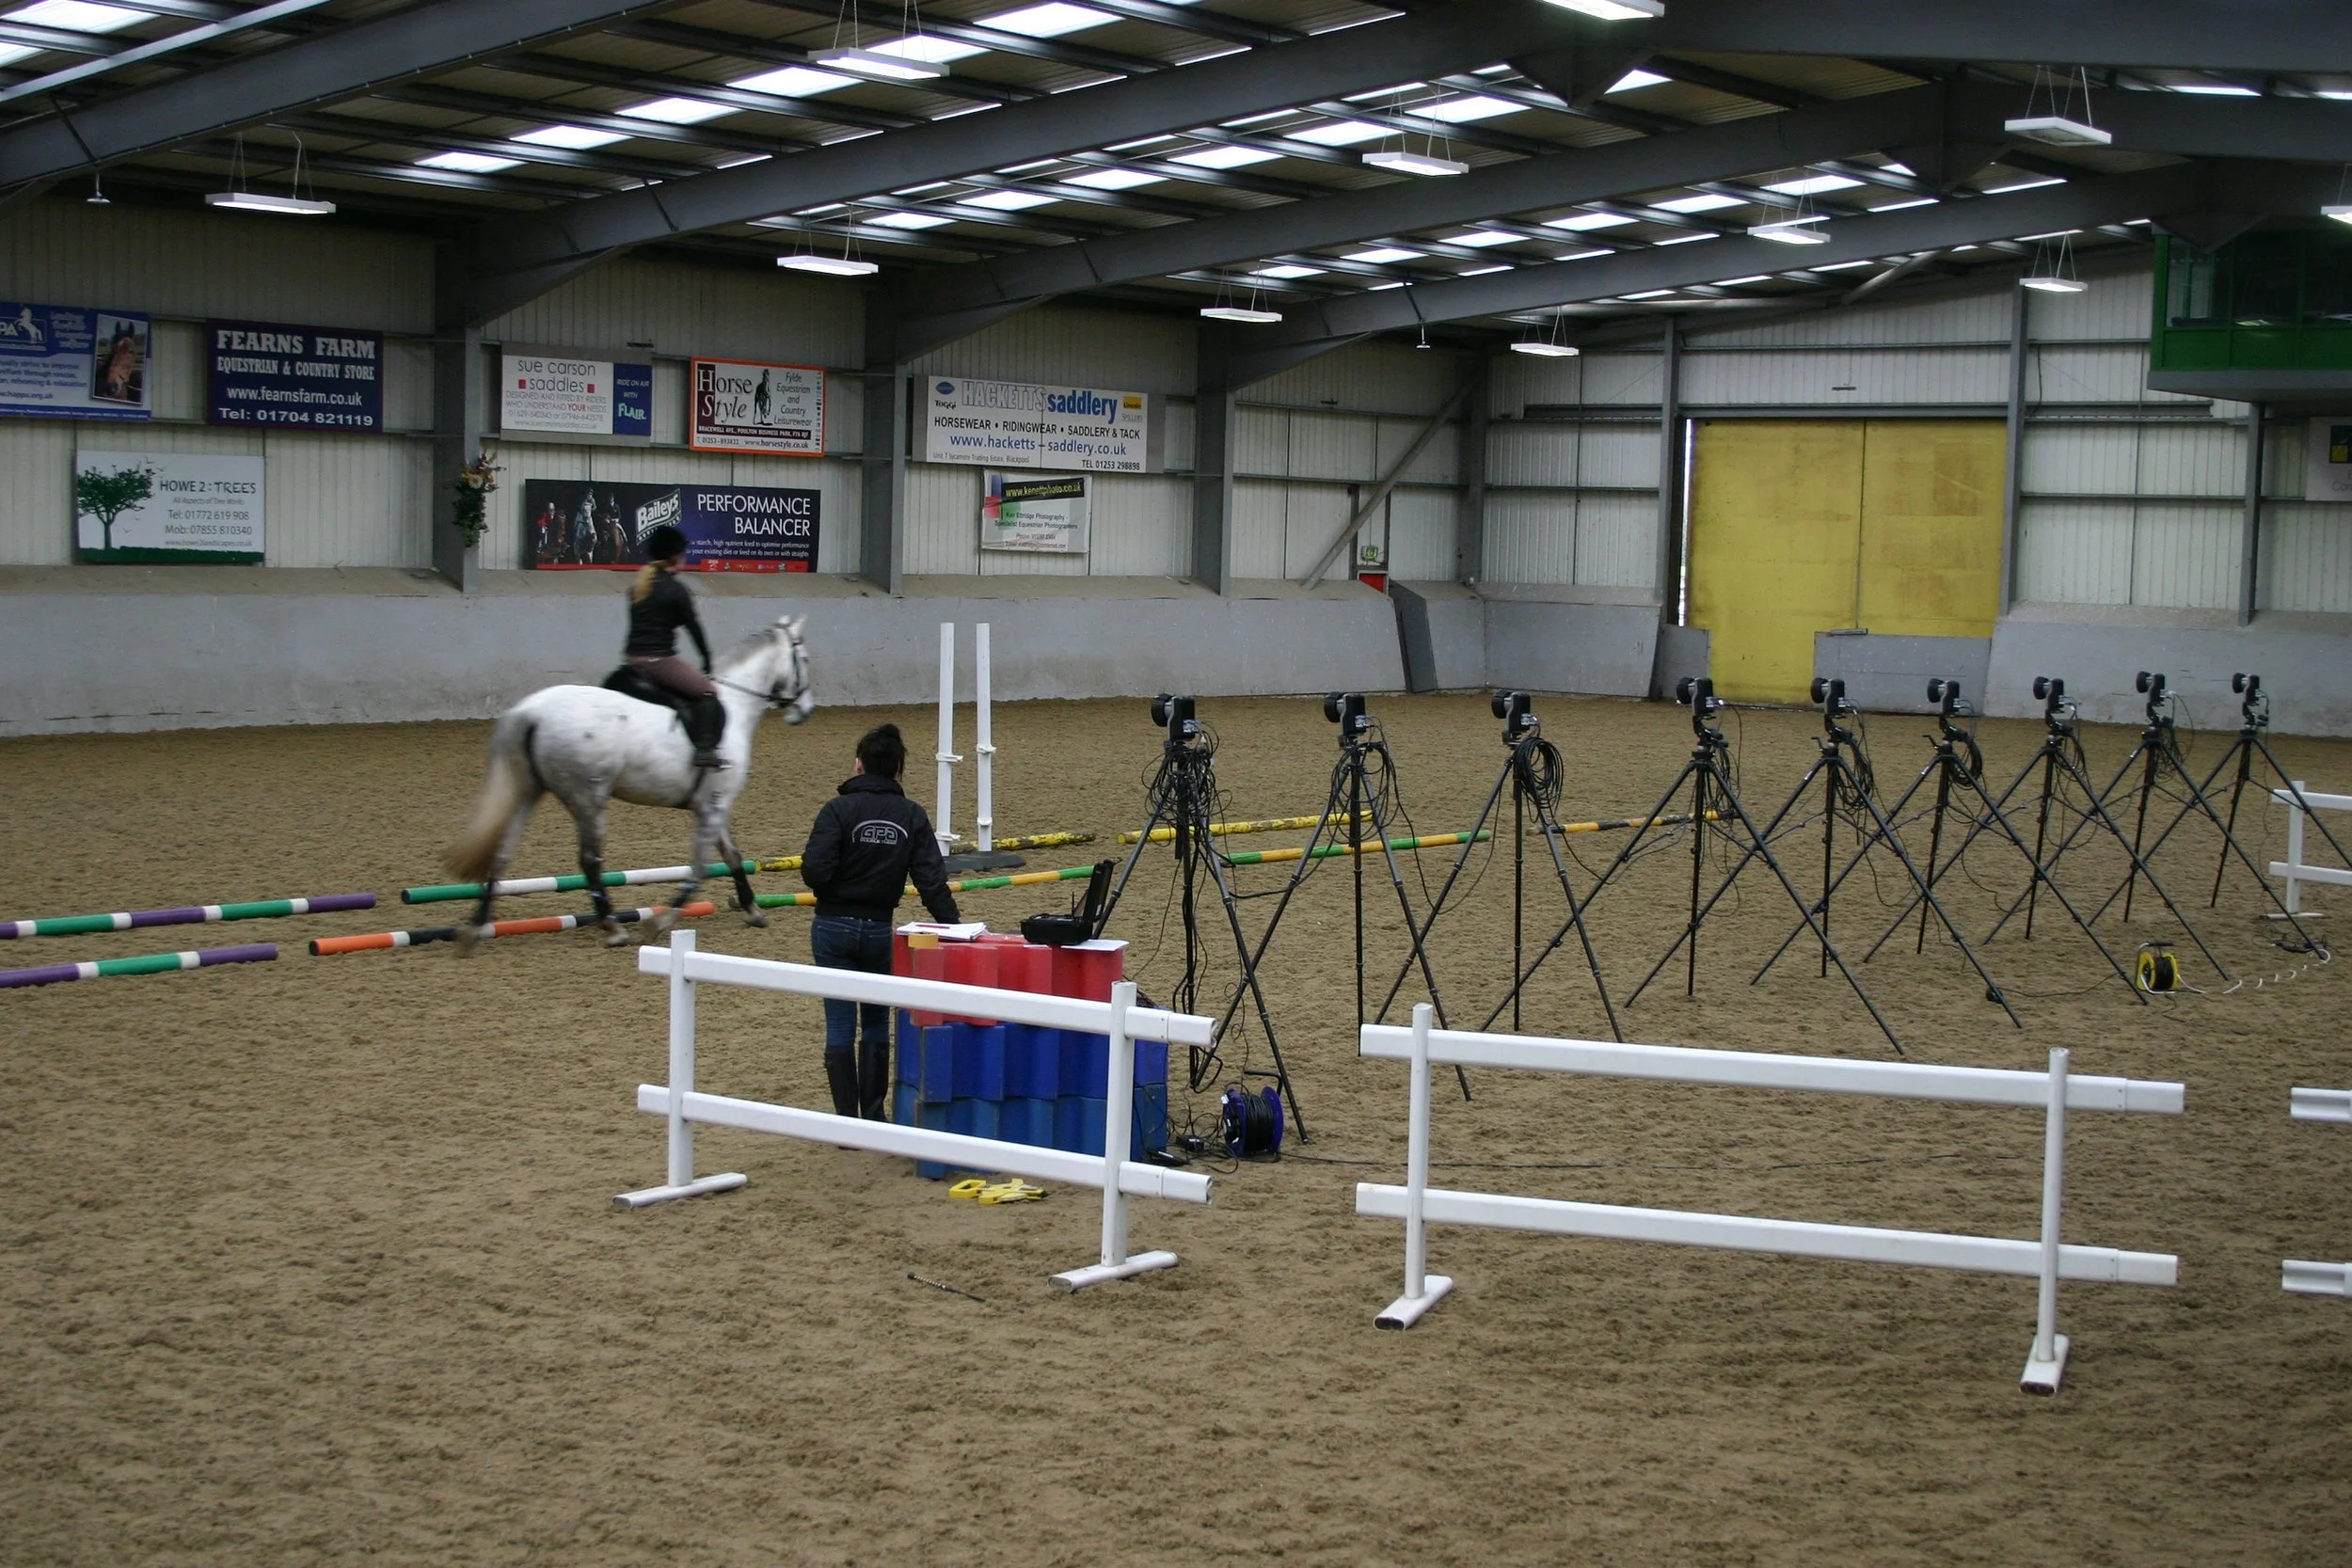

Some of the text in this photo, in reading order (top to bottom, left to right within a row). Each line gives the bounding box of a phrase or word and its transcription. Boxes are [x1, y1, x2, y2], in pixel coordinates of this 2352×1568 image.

[217, 330, 375, 358] FEARNS FARM
[217, 356, 374, 380] EQUESTRIAN & COUNTRY STORE
[517, 359, 596, 376] sue carson
[530, 376, 584, 393] saddles
[698, 370, 753, 394] Horse
[786, 372, 803, 384] Fylde
[227, 386, 362, 405] www.fearnsfarm.co.uk
[505, 390, 539, 400] DESIGNED
[776, 383, 810, 394] Equestrian
[567, 404, 586, 412] YOUR
[787, 396, 799, 404] and
[961, 380, 1118, 424] HACKETTS saddlery
[218, 407, 373, 426] Tel: 01704 821119
[702, 395, 747, 423] Style
[781, 406, 806, 418] Country
[774, 417, 812, 426] Leisurewear
[934, 417, 1140, 440] HORSEWEAR RIDINGWEAR SADDLERY & TACK
[1082, 459, 1093, 468] TEL
[1096, 460, 1115, 469] 01253
[160, 480, 196, 492] HOWE
[215, 482, 256, 495] TREES
[637, 494, 679, 531] Baileys
[697, 493, 811, 515] PERFORMANCE
[184, 510, 212, 519] 01772
[214, 511, 230, 520] 619
[165, 525, 188, 534] Mob:
[190, 525, 217, 535] 07855
[735, 516, 810, 537] BALANCER
